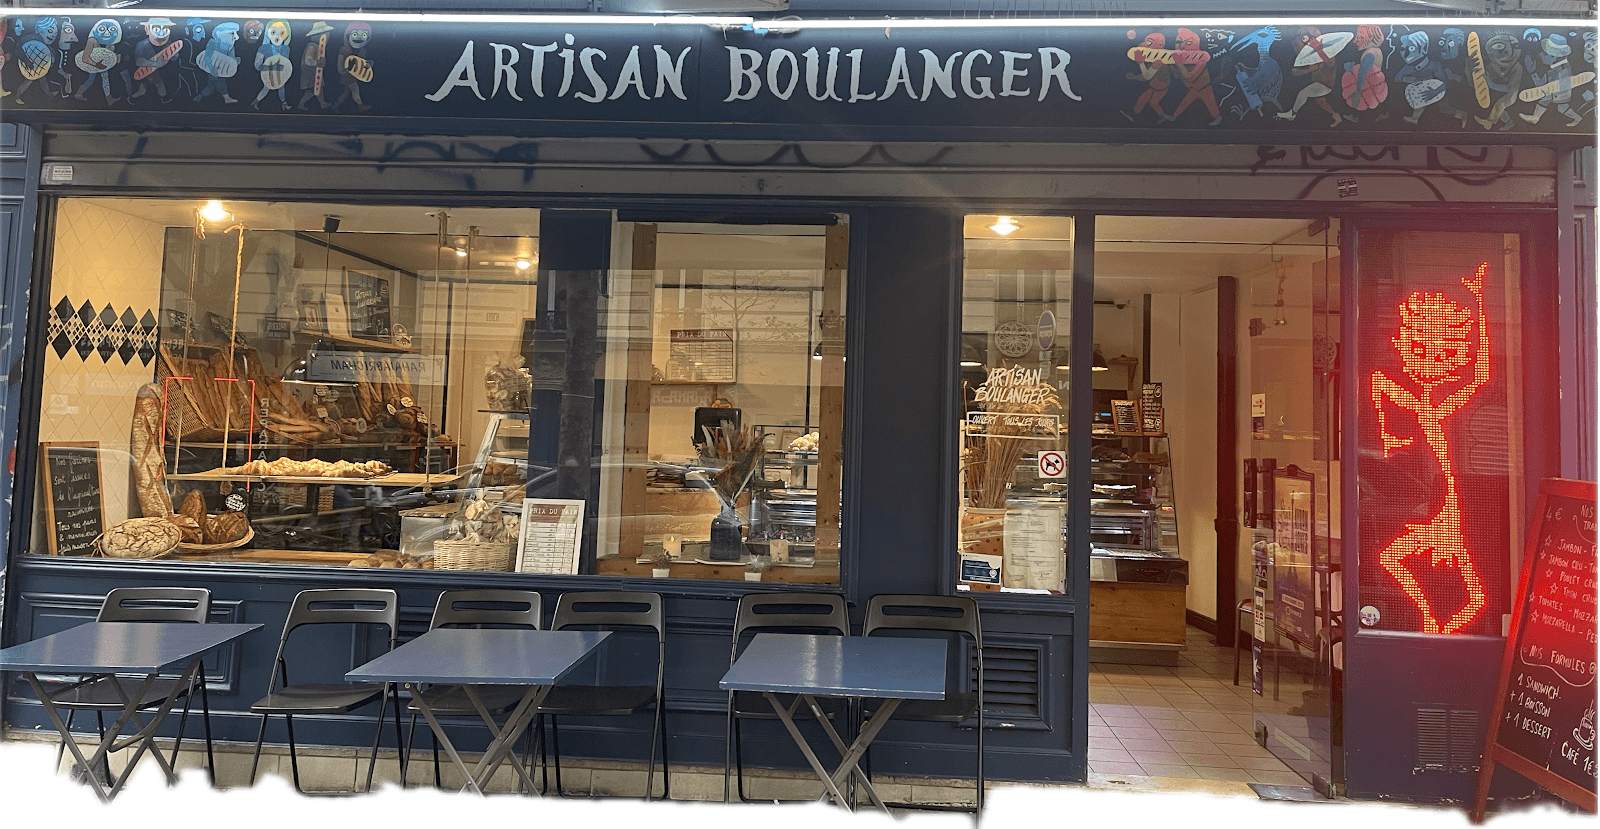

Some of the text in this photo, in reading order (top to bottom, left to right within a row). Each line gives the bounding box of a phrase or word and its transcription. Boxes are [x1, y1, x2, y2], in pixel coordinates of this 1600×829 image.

[723, 46, 1082, 103] BOULANGER
[974, 386, 1050, 405] BOULANGER
[972, 414, 998, 425] OUVERT
[1003, 415, 1020, 426] TOUS
[1018, 417, 1034, 427] LES
[529, 507, 546, 515] PRIX
[1557, 538, 1582, 554] JAMBON
[1548, 554, 1569, 568] JAMBON
[1571, 560, 1583, 571] CRU
[1538, 595, 1563, 612] TOMATES
[1529, 645, 1586, 674] NOS FORMULES
[1524, 697, 1551, 718] BOISSON
[1522, 717, 1553, 739] DESSERT
[1561, 740, 1580, 765] CAFÉ
